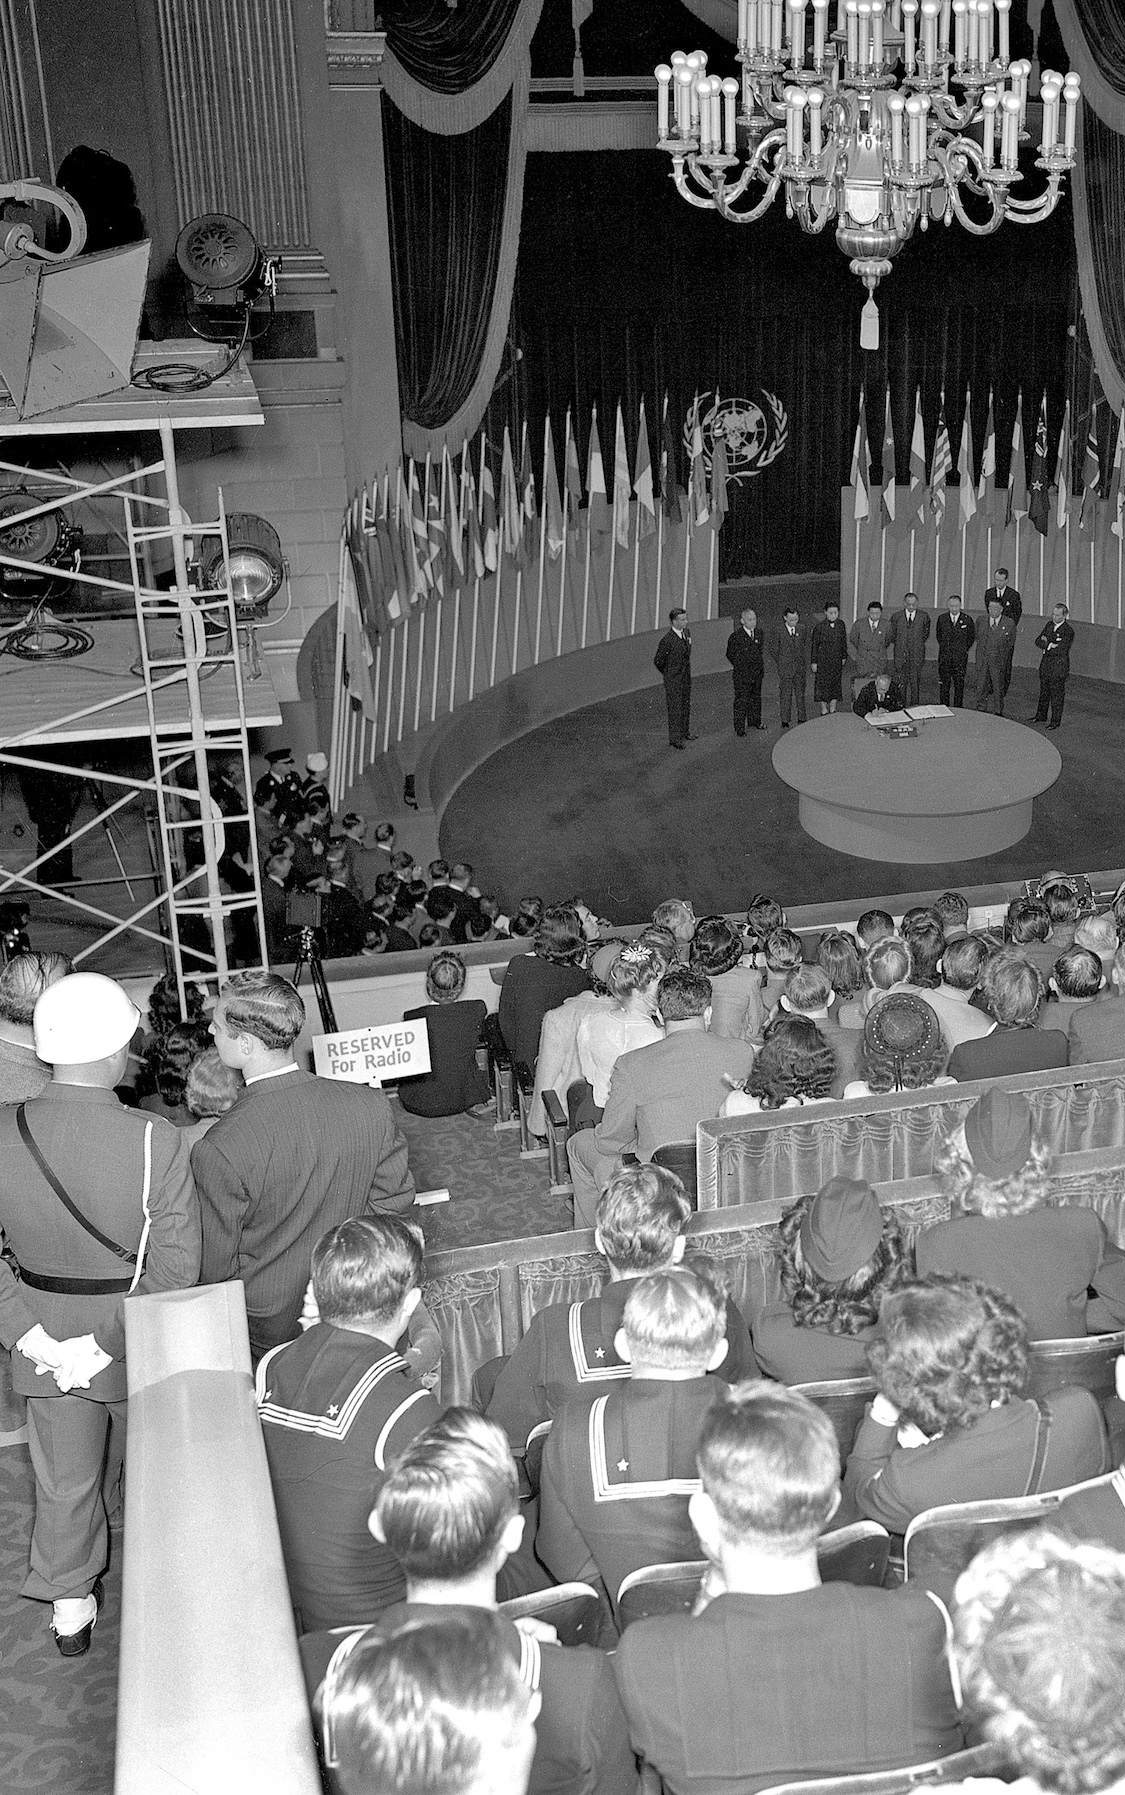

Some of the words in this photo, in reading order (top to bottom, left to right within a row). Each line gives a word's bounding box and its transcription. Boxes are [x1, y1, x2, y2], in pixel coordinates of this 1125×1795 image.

[327, 1031, 415, 1057] RESERVED
[331, 1060, 356, 1074] For
[365, 1048, 411, 1069] Radio
